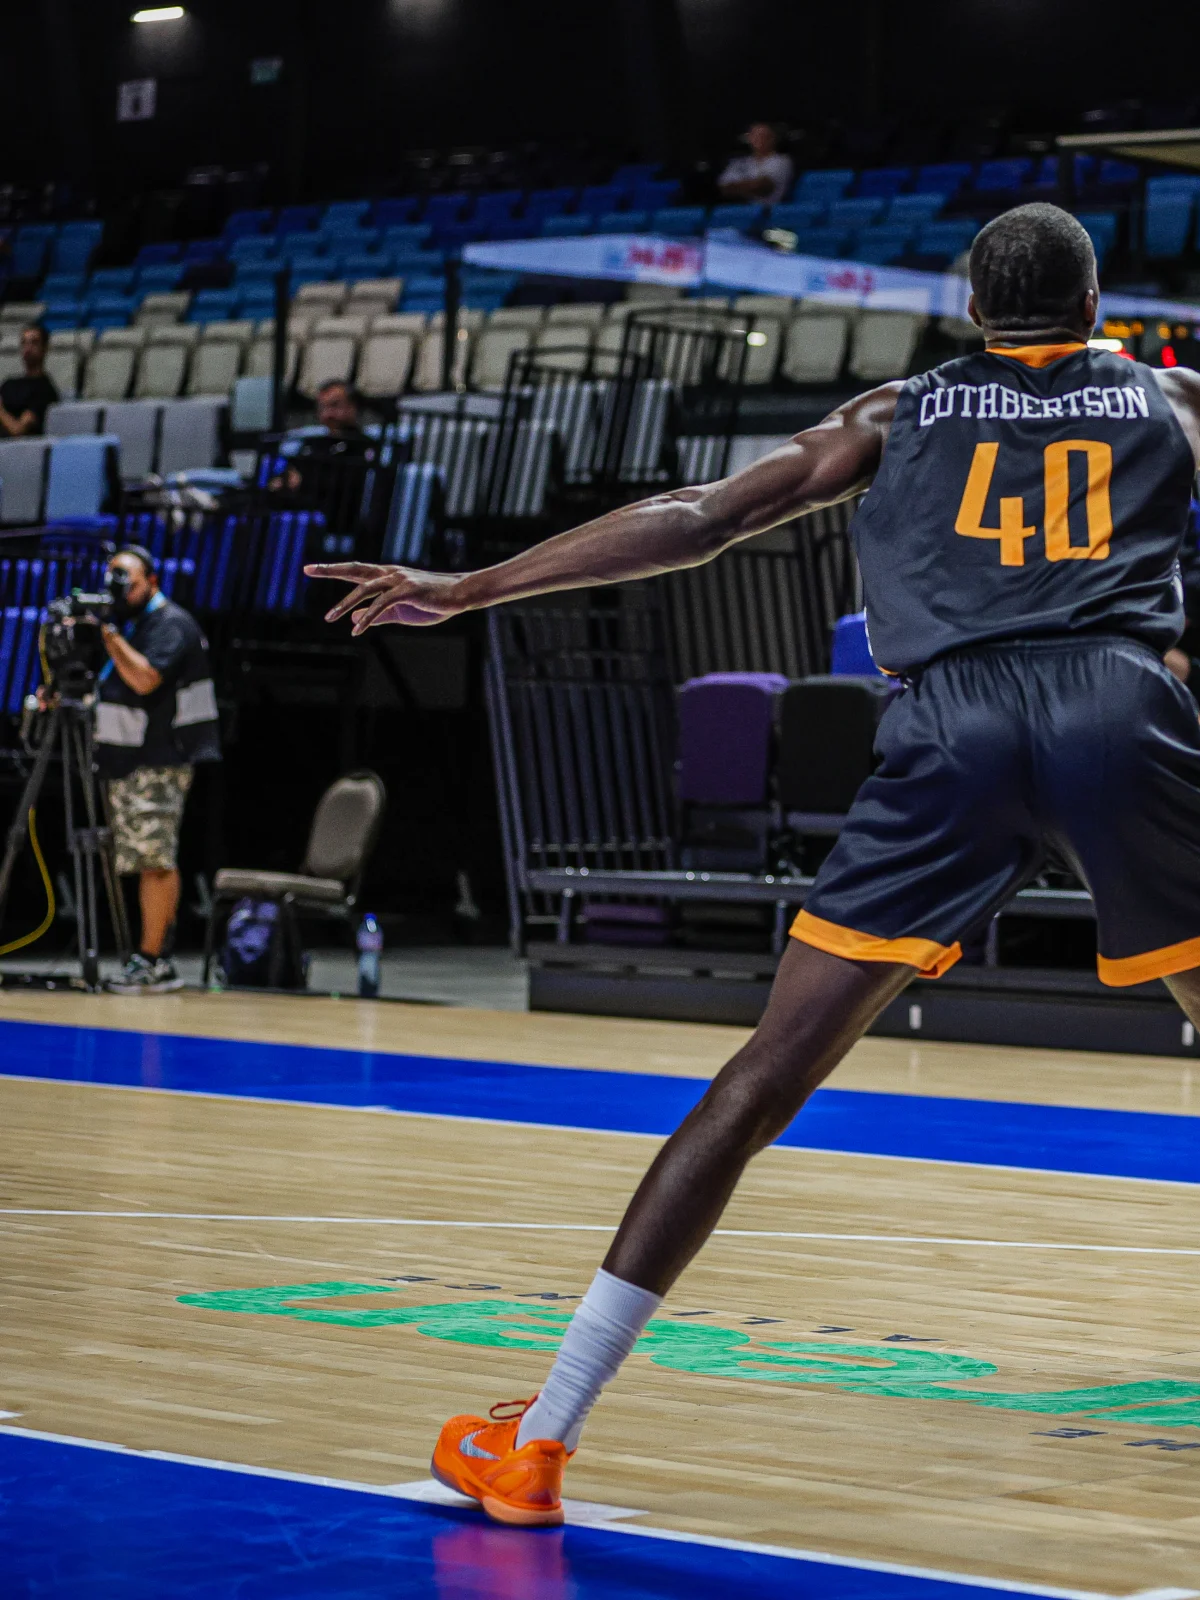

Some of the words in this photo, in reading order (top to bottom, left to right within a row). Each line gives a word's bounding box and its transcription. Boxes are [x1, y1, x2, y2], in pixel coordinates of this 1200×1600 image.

[919, 383, 1150, 427] CUTHBERTSON
[954, 439, 1113, 566] 40
[376, 1275, 944, 1342] ALLINCE
